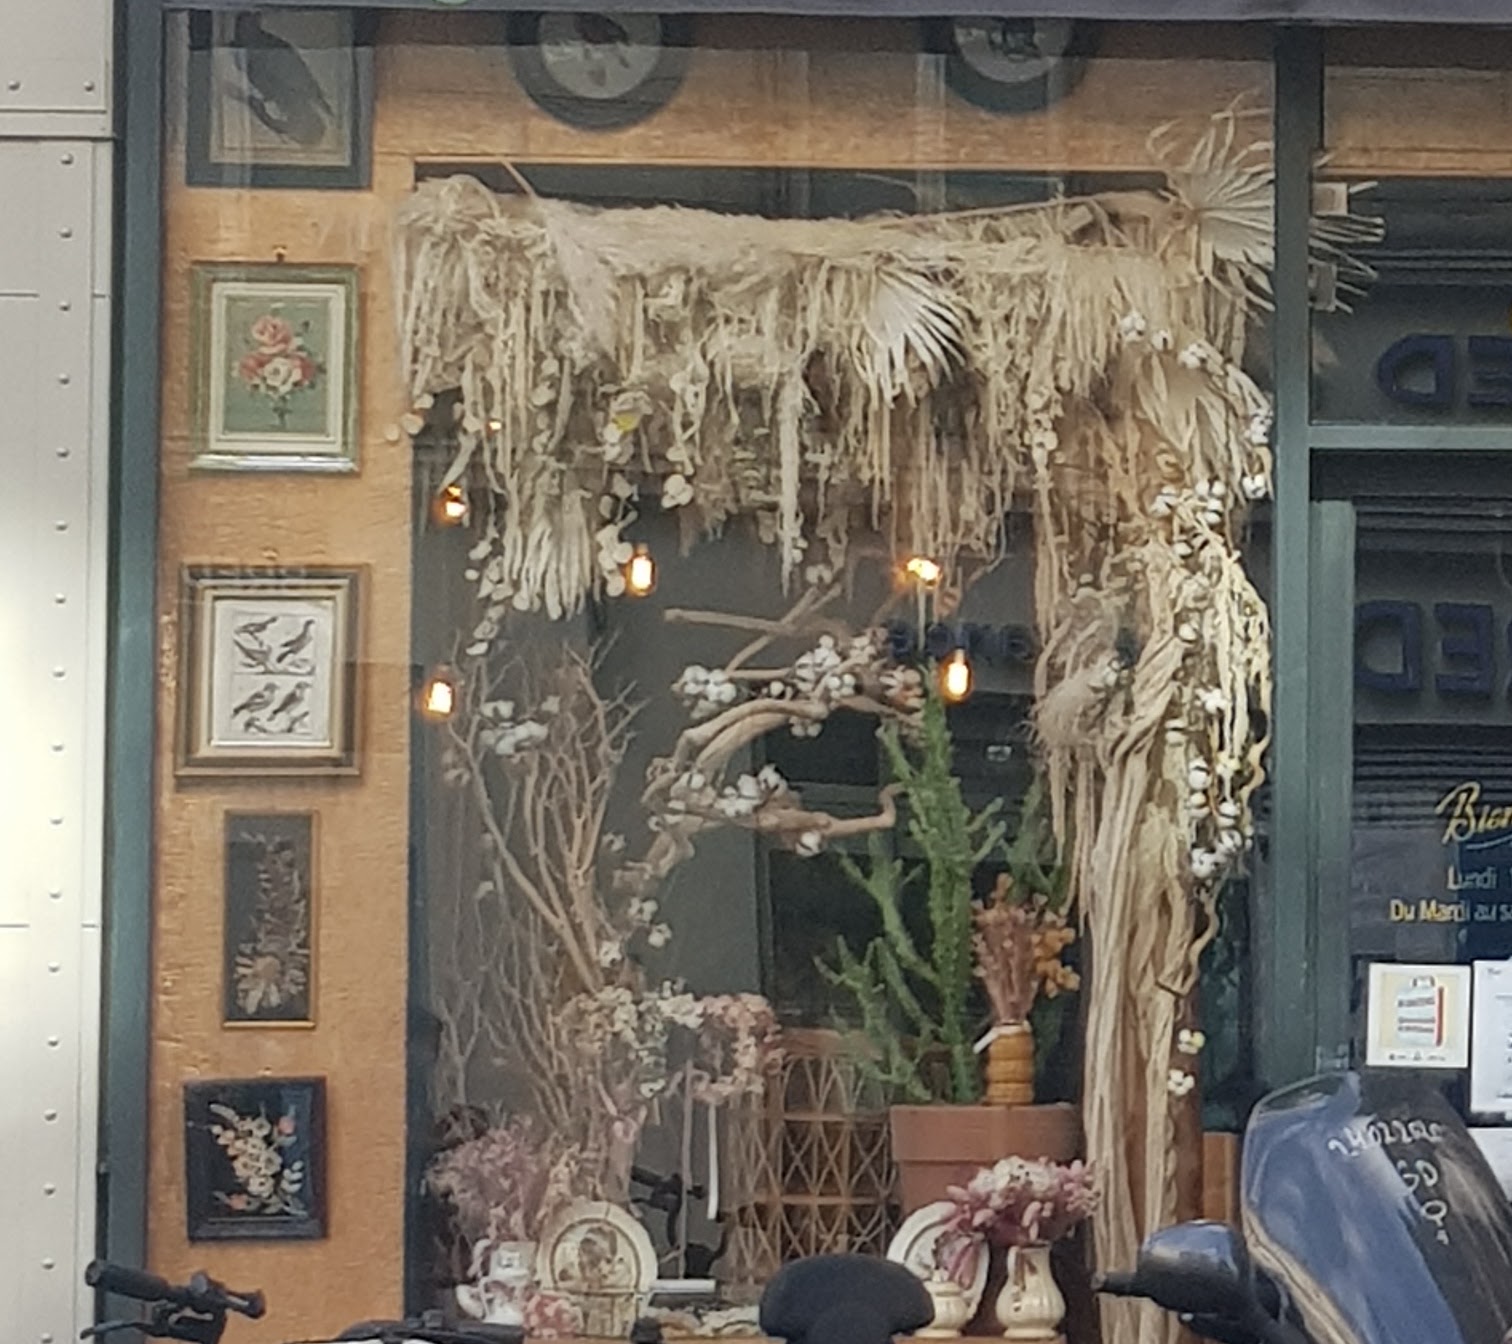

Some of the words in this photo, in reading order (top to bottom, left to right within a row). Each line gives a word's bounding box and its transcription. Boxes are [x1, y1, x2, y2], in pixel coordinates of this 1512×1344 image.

[1447, 866, 1498, 891] Lundi
[1389, 899, 1415, 922] Du
[1419, 899, 1470, 923] Mardi
[1474, 903, 1497, 922] au
